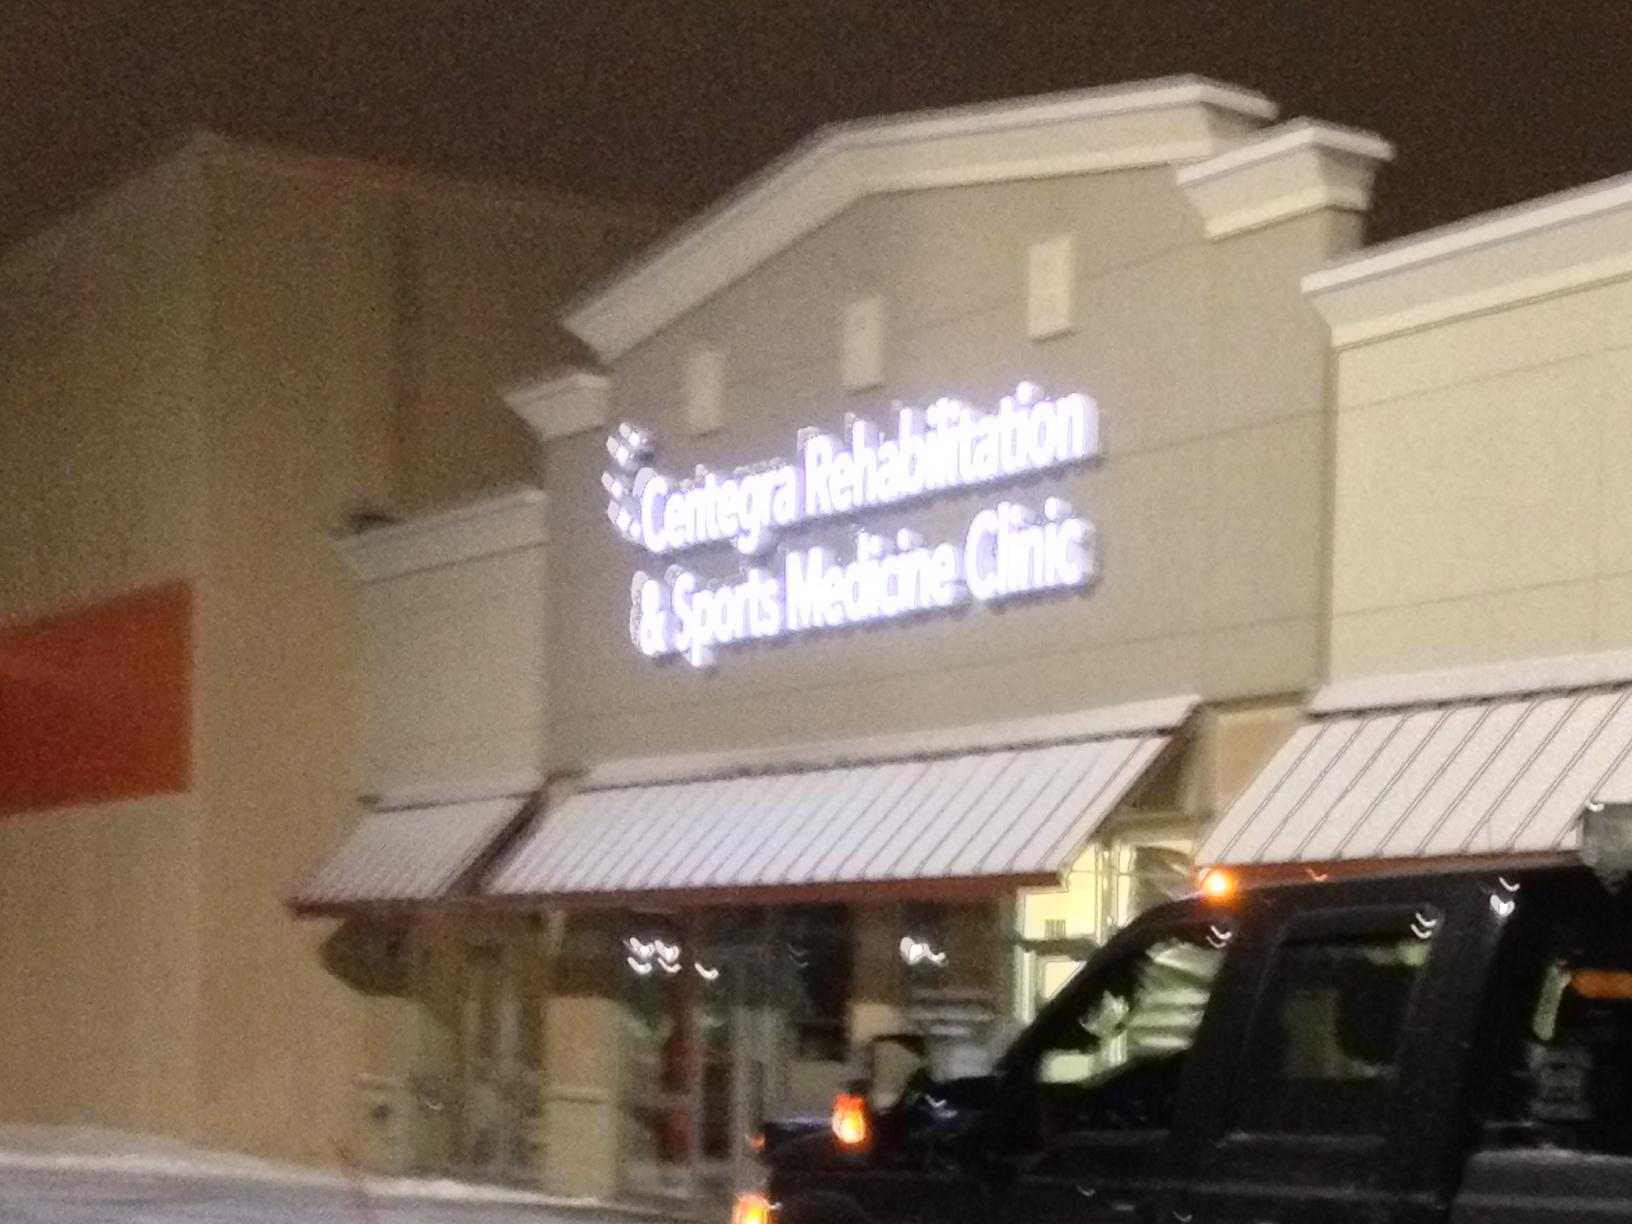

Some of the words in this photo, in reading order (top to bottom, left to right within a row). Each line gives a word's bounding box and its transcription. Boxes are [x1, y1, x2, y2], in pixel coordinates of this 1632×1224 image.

[641, 465, 798, 553] Centegra
[803, 382, 1092, 515] Rehabilitation
[636, 570, 668, 655] &
[672, 568, 781, 667] Sports
[785, 528, 956, 630] Medicine
[965, 496, 1085, 600] Clinic
